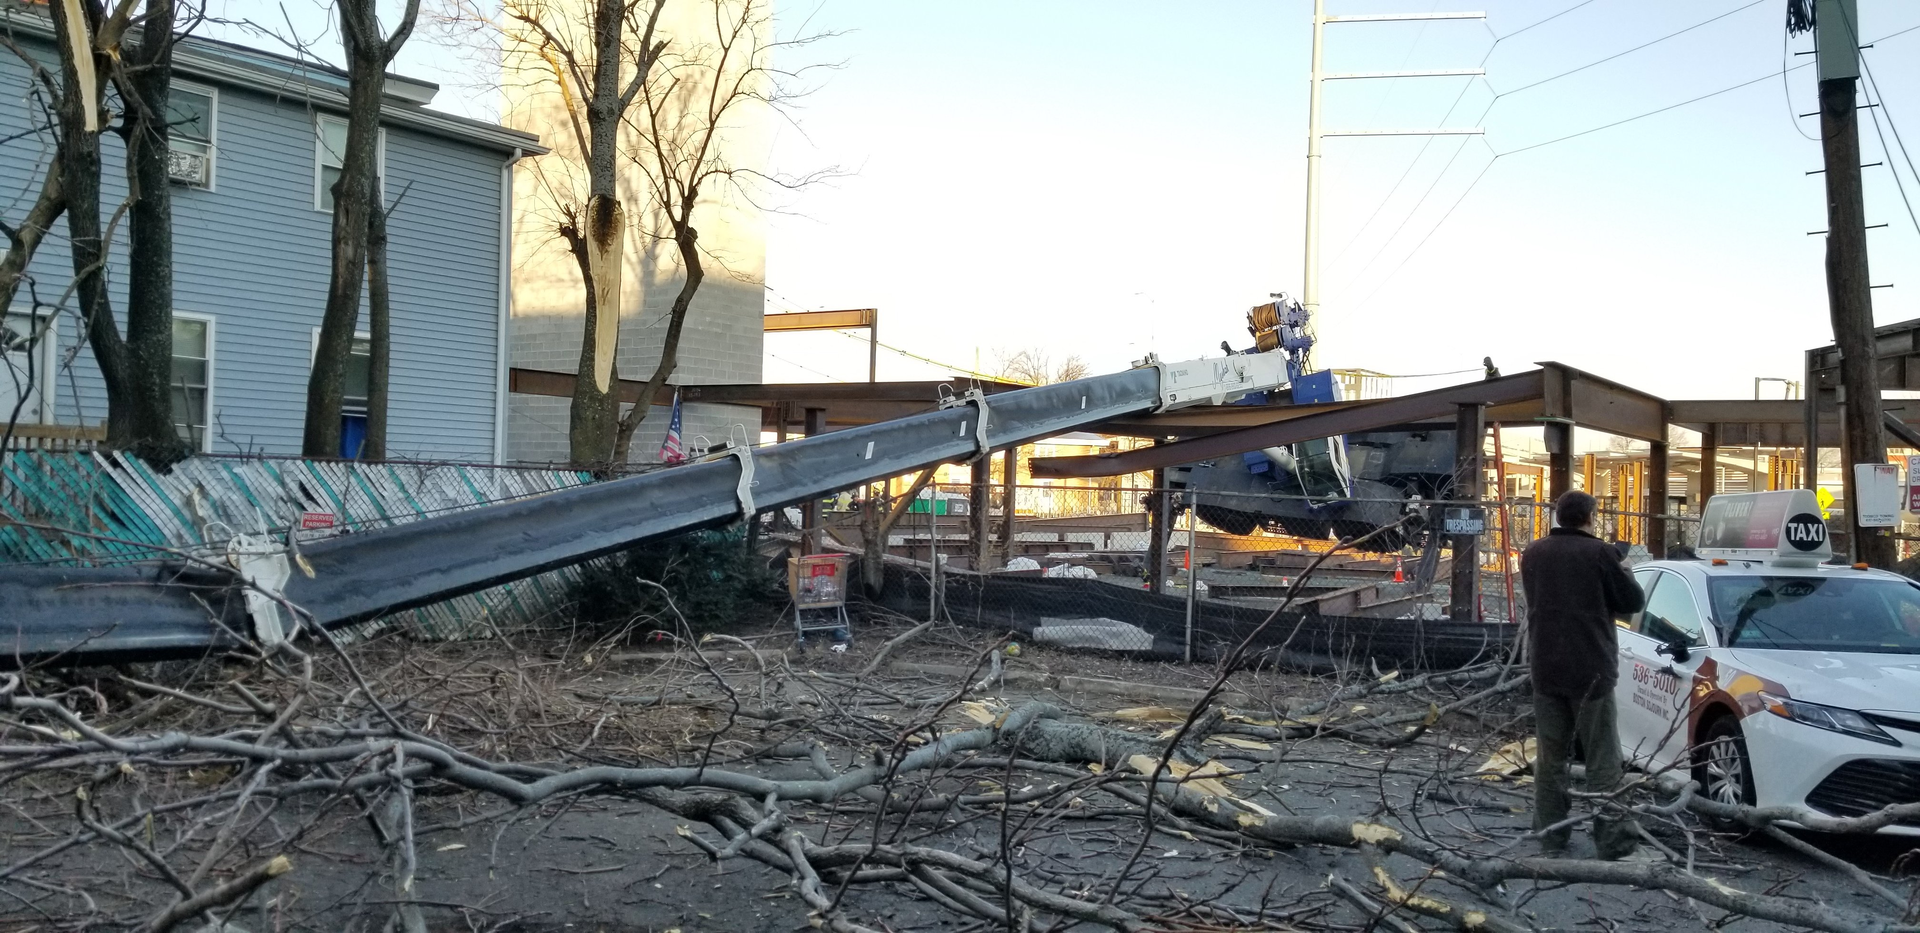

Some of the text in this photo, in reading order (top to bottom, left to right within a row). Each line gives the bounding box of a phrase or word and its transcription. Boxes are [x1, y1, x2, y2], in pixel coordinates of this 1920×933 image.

[1446, 519, 1483, 531] TRESPASSING
[1788, 522, 1824, 542] TAXI
[1633, 663, 1677, 695] 536-5010
